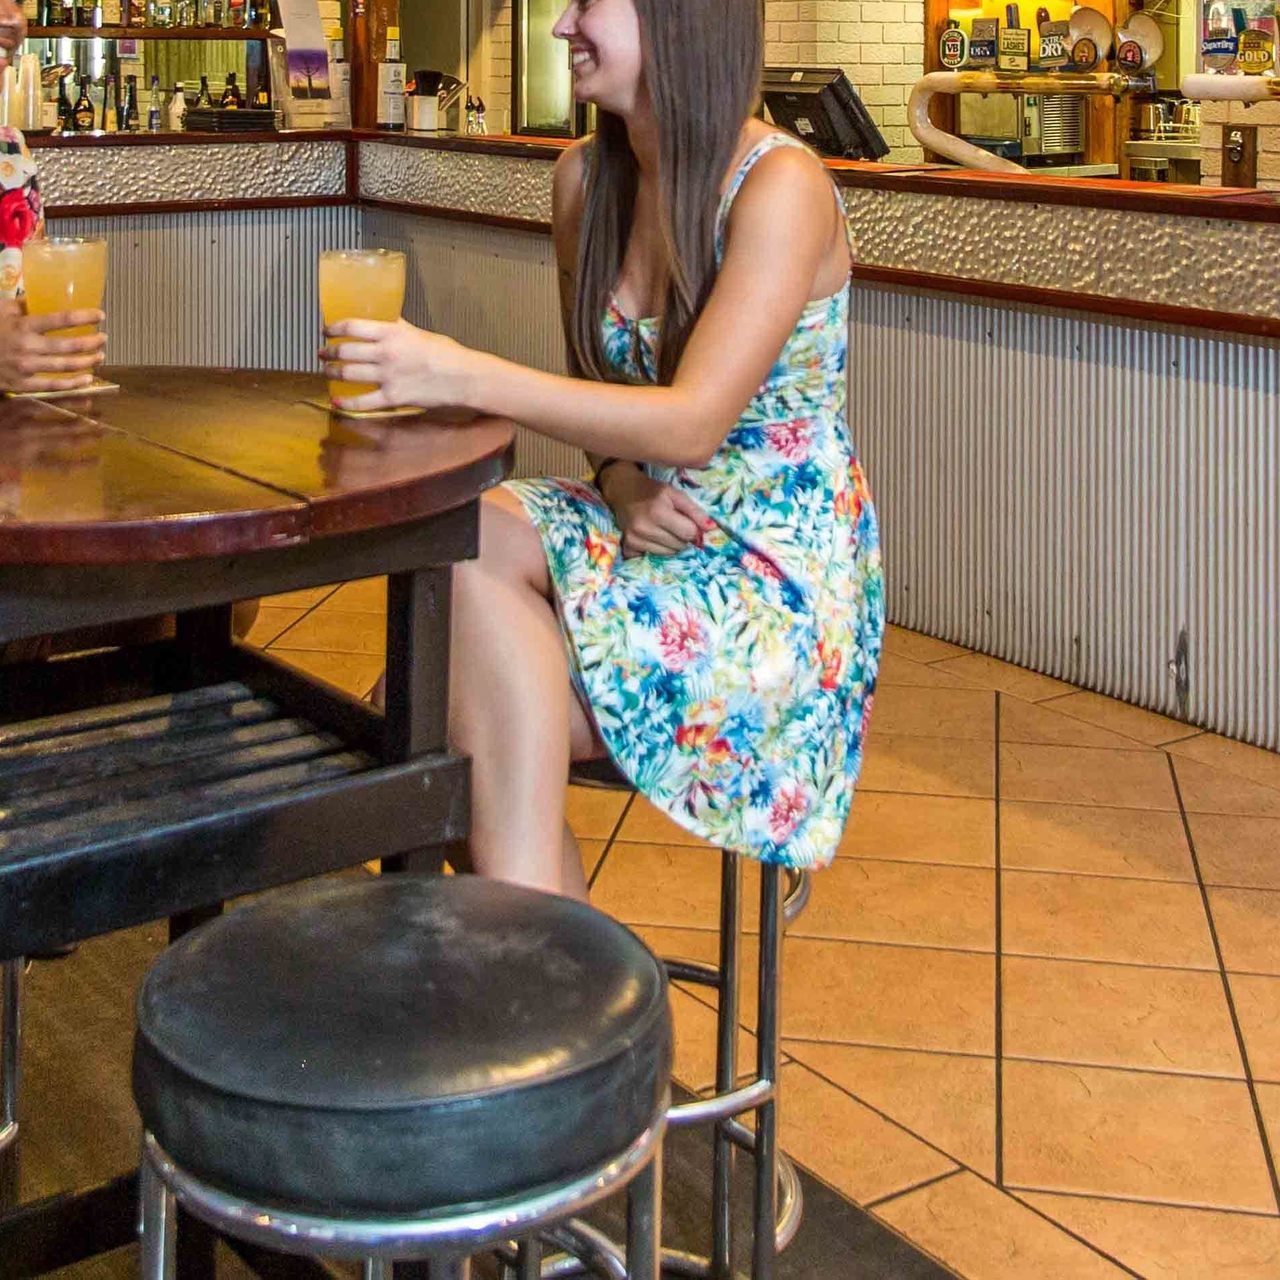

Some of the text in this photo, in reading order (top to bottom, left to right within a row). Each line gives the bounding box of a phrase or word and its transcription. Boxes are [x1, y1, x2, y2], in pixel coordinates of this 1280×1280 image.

[947, 43, 960, 53] VB
[1040, 43, 1064, 58] DRY
[1237, 51, 1269, 62] GOLD
